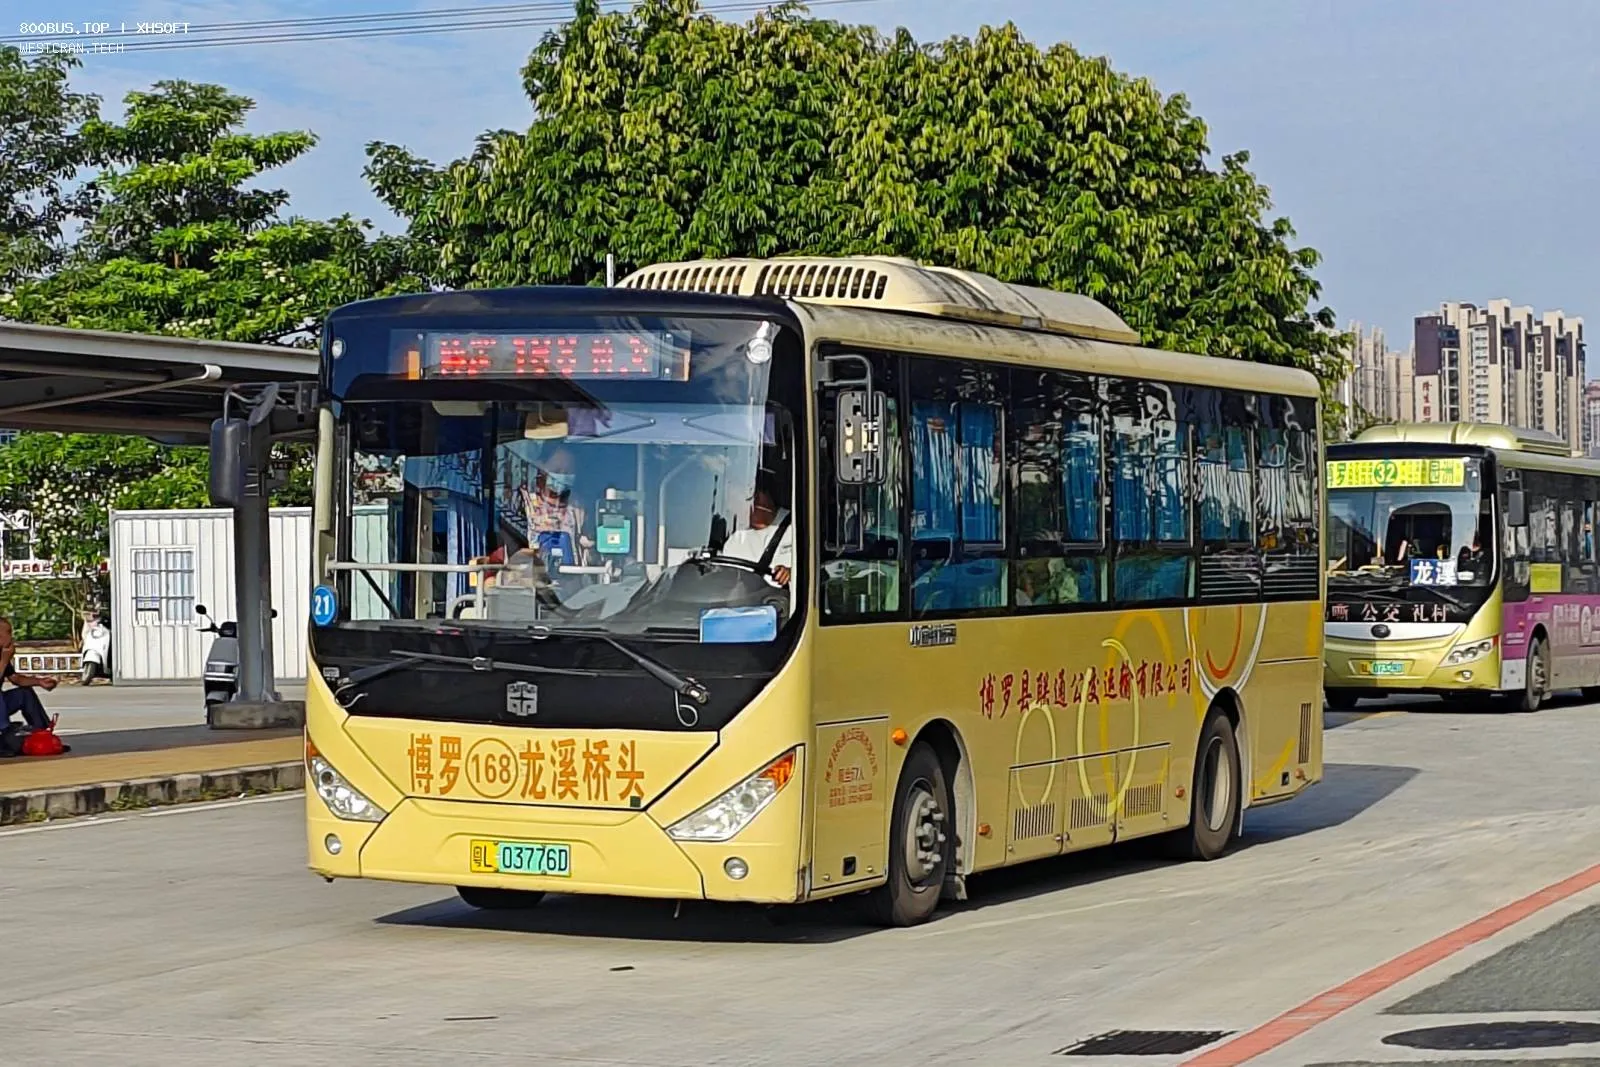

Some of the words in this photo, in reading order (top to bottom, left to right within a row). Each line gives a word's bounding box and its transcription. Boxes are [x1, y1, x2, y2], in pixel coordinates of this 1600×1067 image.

[1376, 462, 1396, 483] 32
[314, 594, 330, 616] 21
[407, 733, 462, 796] 博罗
[471, 753, 512, 785] 168
[519, 737, 645, 801] 龙溪桥头
